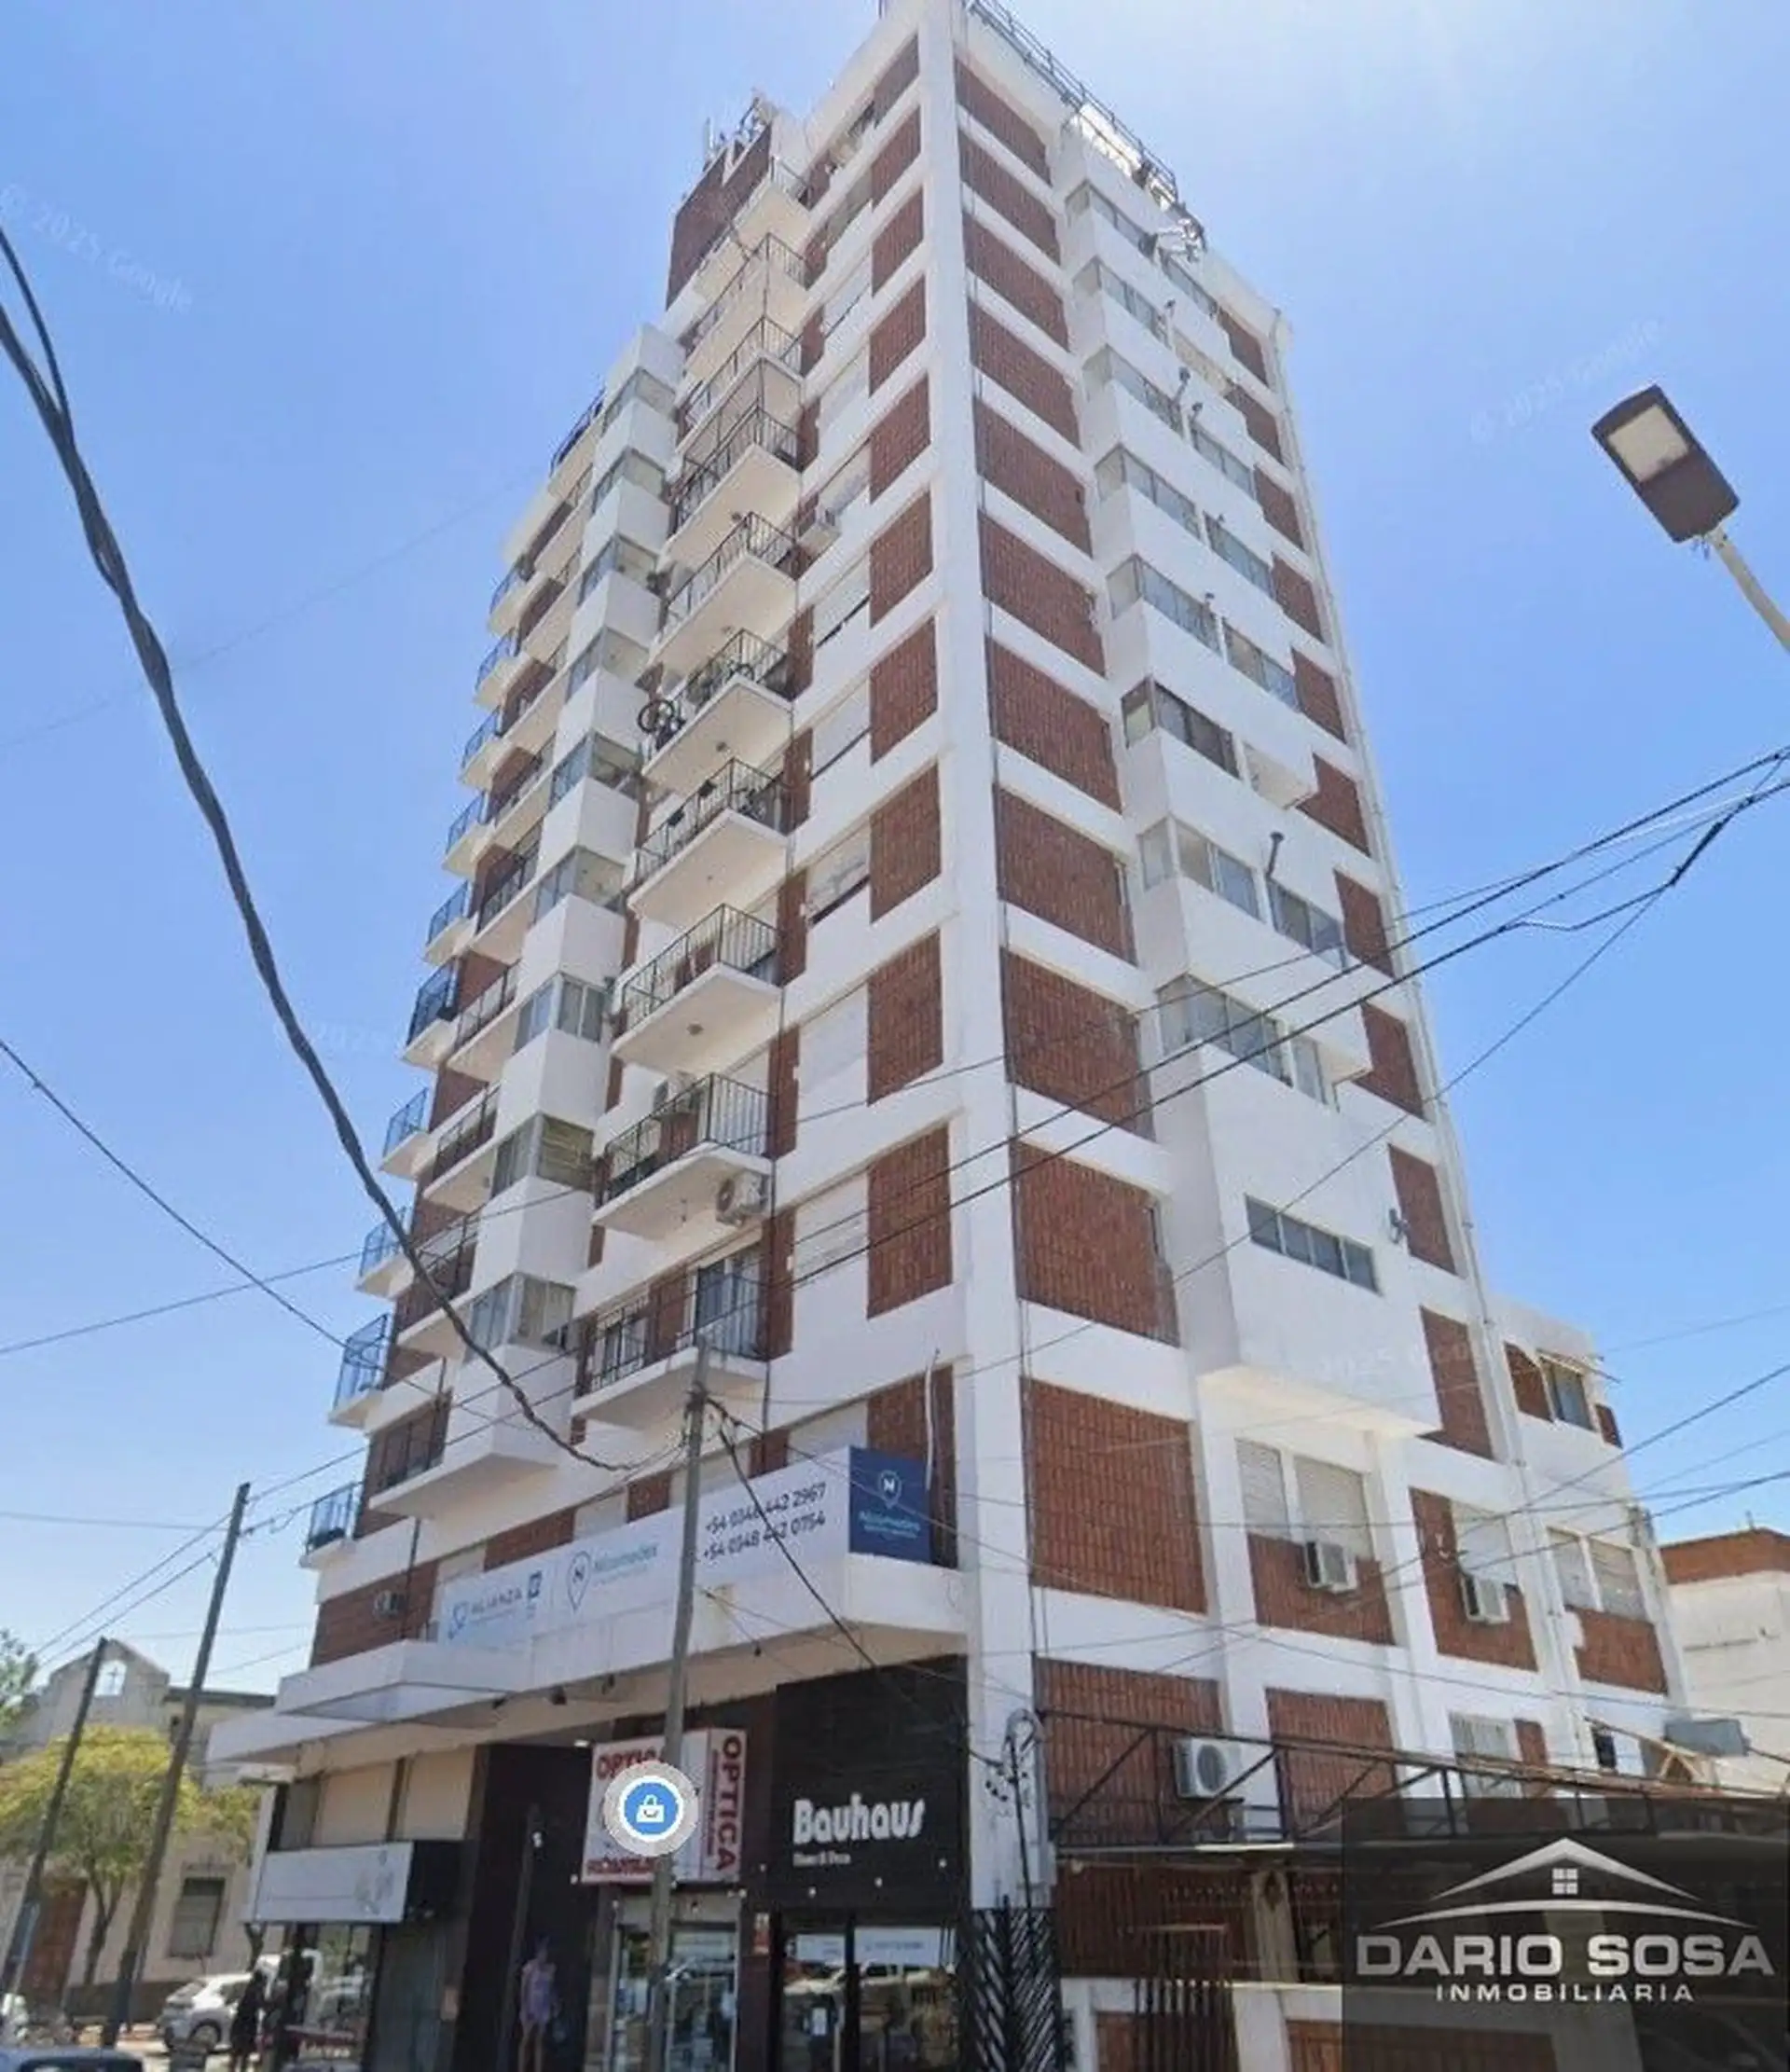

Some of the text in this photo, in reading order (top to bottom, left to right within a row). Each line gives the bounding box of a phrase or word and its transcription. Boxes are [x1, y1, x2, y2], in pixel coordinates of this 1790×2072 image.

[597, 1746, 665, 1780] OPTIC
[716, 1734, 742, 1871] OPTICA
[792, 1791, 926, 1845] Bauhaus
